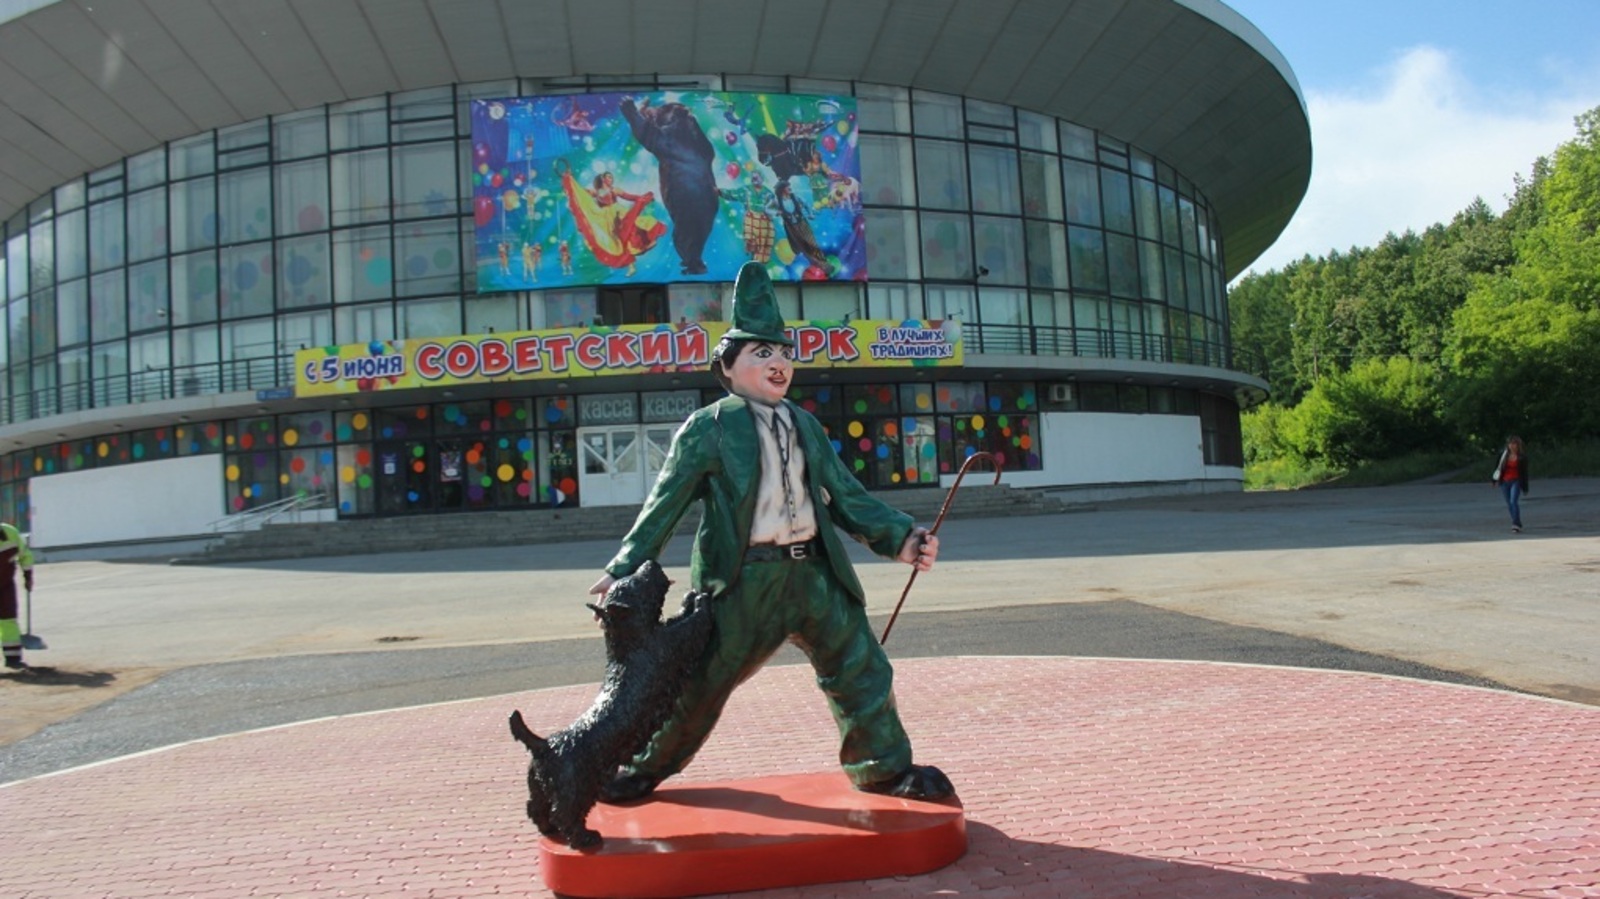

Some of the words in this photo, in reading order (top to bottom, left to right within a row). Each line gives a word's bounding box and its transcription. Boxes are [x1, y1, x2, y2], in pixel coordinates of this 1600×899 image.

[878, 328, 889, 341] В
[891, 328, 943, 342] ЛУЧШИХ
[415, 326, 708, 379] СОВЕТСКИЙ
[871, 343, 953, 358] ТРАДИЦИЯХ!
[322, 357, 339, 380] 5
